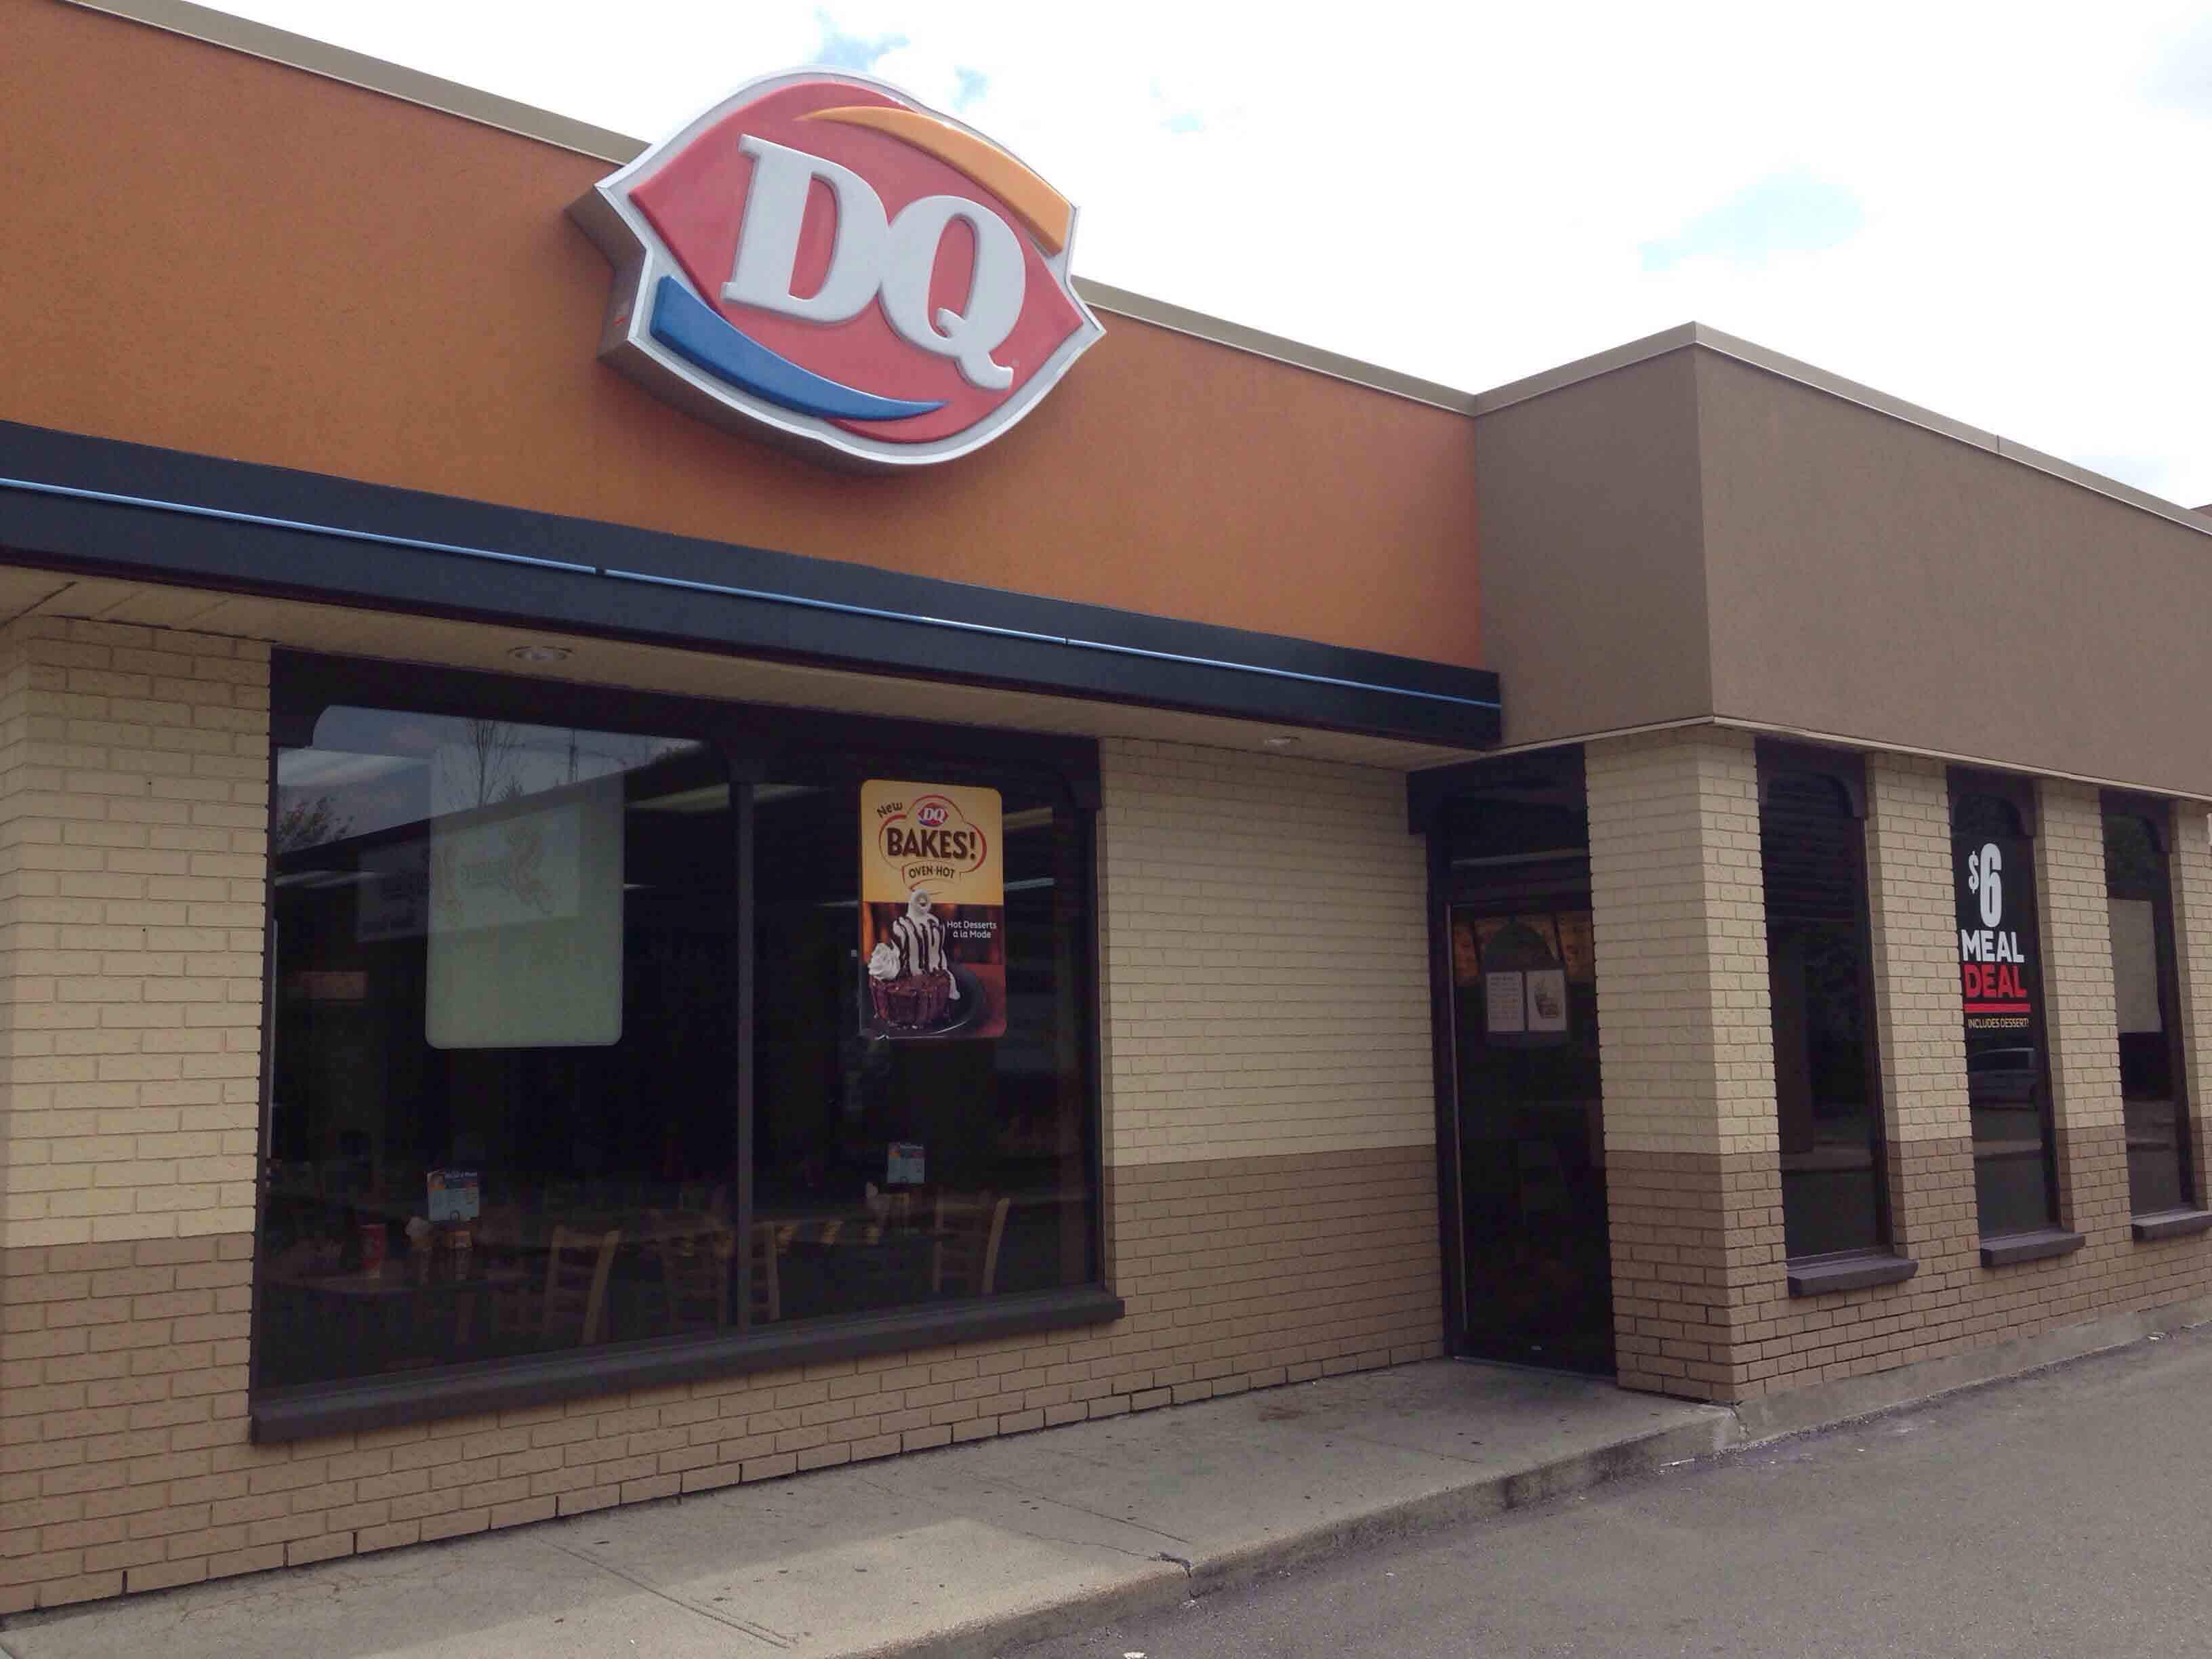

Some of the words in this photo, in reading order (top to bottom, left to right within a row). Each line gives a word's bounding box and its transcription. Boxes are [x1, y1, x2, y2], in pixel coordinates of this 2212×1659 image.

[721, 134, 1025, 389] DQ
[877, 801, 903, 818] New
[922, 807, 945, 823] DQ
[886, 827, 976, 861] BAKES!
[909, 865, 933, 879] OVEN
[936, 865, 955, 879] HOT
[1968, 842, 2002, 928] $6
[963, 921, 998, 929] Desserts
[969, 930, 991, 939] Mode
[1961, 929, 2025, 963] MEAL
[1963, 964, 2027, 998] DEAL
[1967, 1018, 2000, 1029] INCLUDES
